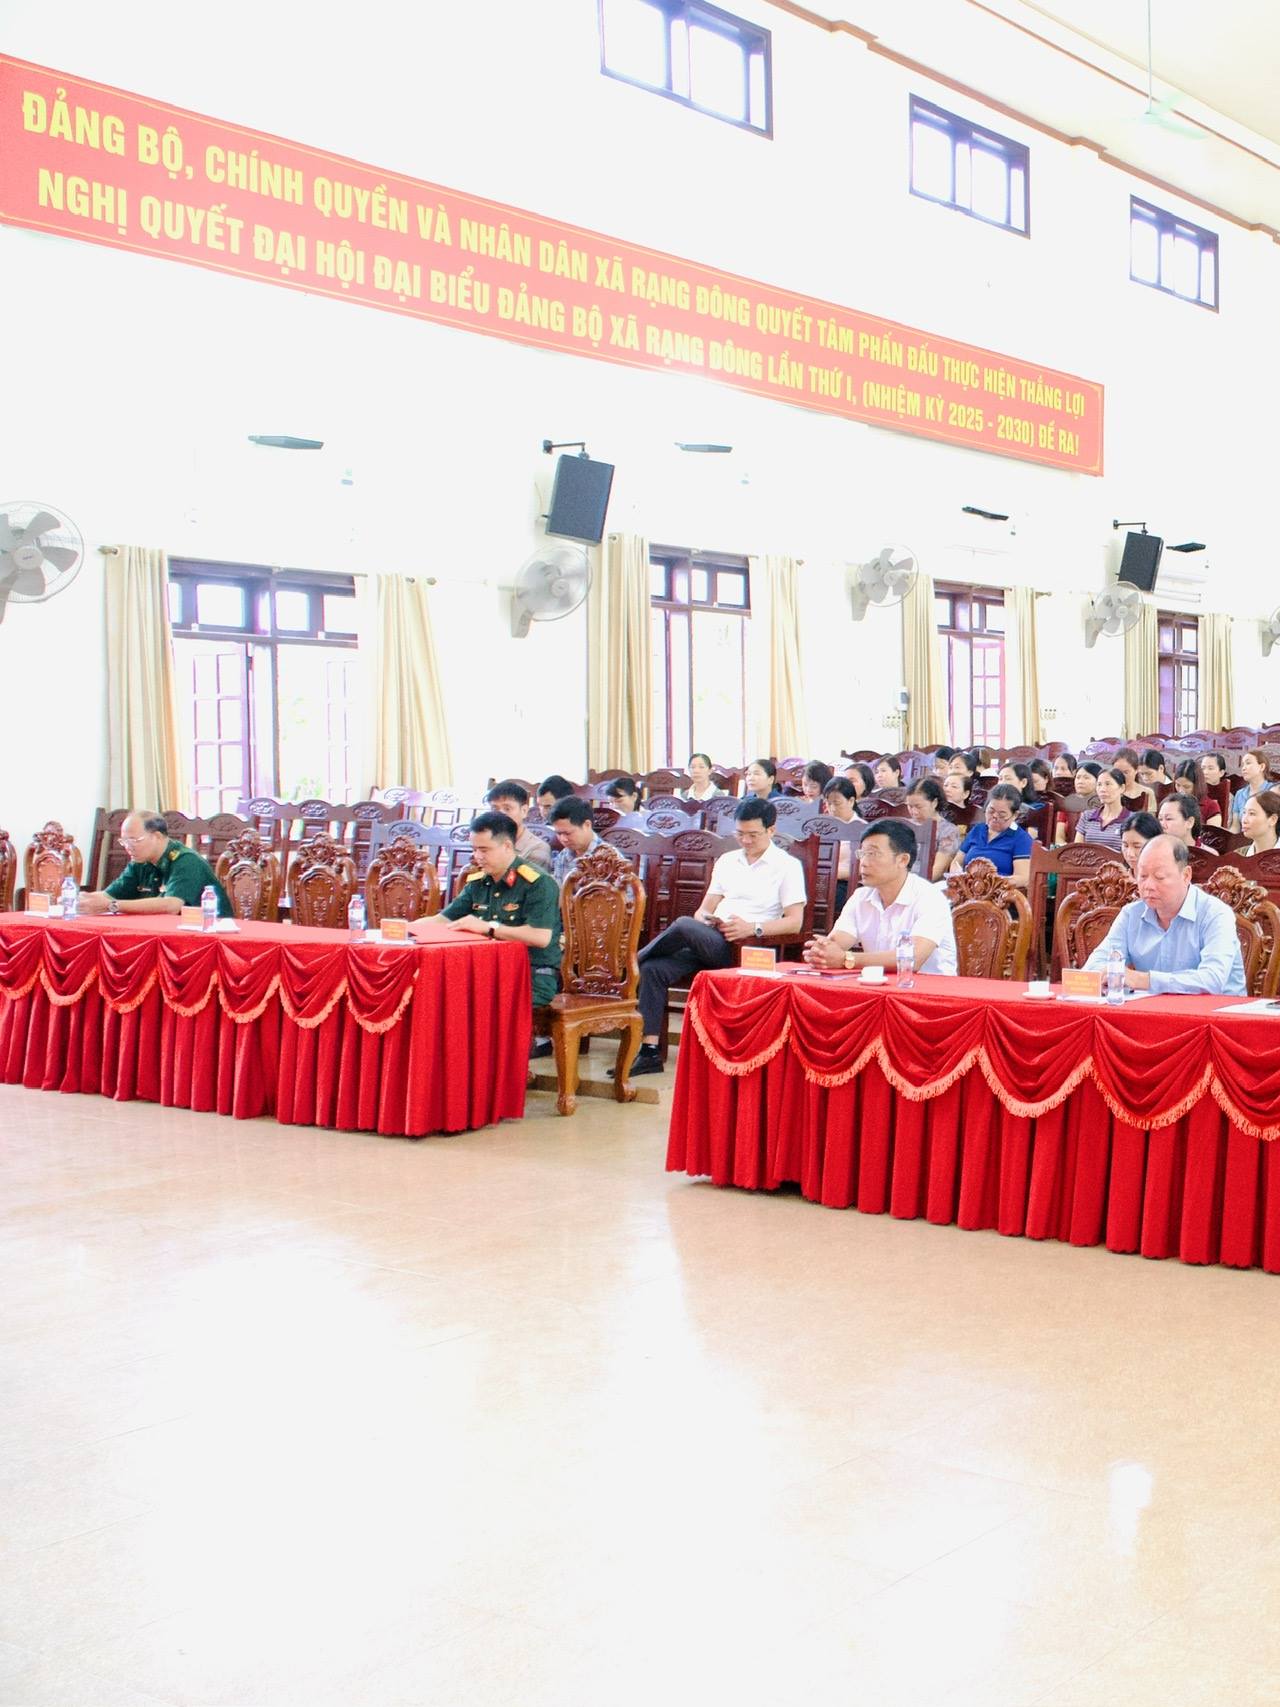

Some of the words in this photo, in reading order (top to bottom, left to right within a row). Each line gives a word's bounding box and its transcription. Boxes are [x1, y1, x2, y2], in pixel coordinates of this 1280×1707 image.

[22, 88, 126, 156] ĐẢNG
[138, 125, 194, 181] BỘ,
[205, 146, 304, 205] CHÍNH
[313, 176, 409, 234] QUYỀN
[416, 204, 452, 247] VÀ
[460, 218, 531, 268] NHÂN
[539, 240, 588, 282] DÂN
[595, 256, 625, 293] XÃ
[632, 266, 690, 310] RẠNG
[696, 285, 751, 327] ĐÔNG
[756, 303, 813, 343] QUYẾT
[817, 317, 854, 355] TÂM
[859, 331, 903, 368] PHẤN
[907, 342, 938, 377] ĐẤU
[943, 356, 980, 391] THỰC
[984, 367, 1016, 400] HIỆN
[1019, 375, 1062, 410] THẮNG
[1066, 391, 1085, 420] LỢI
[38, 168, 128, 235] NGHỊ
[140, 195, 244, 255] QUYẾT
[253, 224, 306, 275] ĐẠI
[316, 239, 365, 288] HỘI
[374, 255, 421, 302] ĐẠI
[430, 266, 490, 314] BIỂU
[498, 282, 565, 333] ĐẢNG
[572, 305, 603, 347] BỘ
[610, 315, 640, 351] XÃ
[646, 325, 704, 365] RẠNG
[709, 340, 763, 380] ĐÔNG
[767, 350, 804, 390] LẦN
[808, 366, 843, 398] THỨ
[846, 376, 857, 405] I,
[863, 380, 921, 418] (NHIỆM
[925, 394, 945, 422] KỲ
[949, 403, 984, 432] 2025
[997, 414, 1034, 447] 2030)
[1059, 429, 1079, 456] RA!
